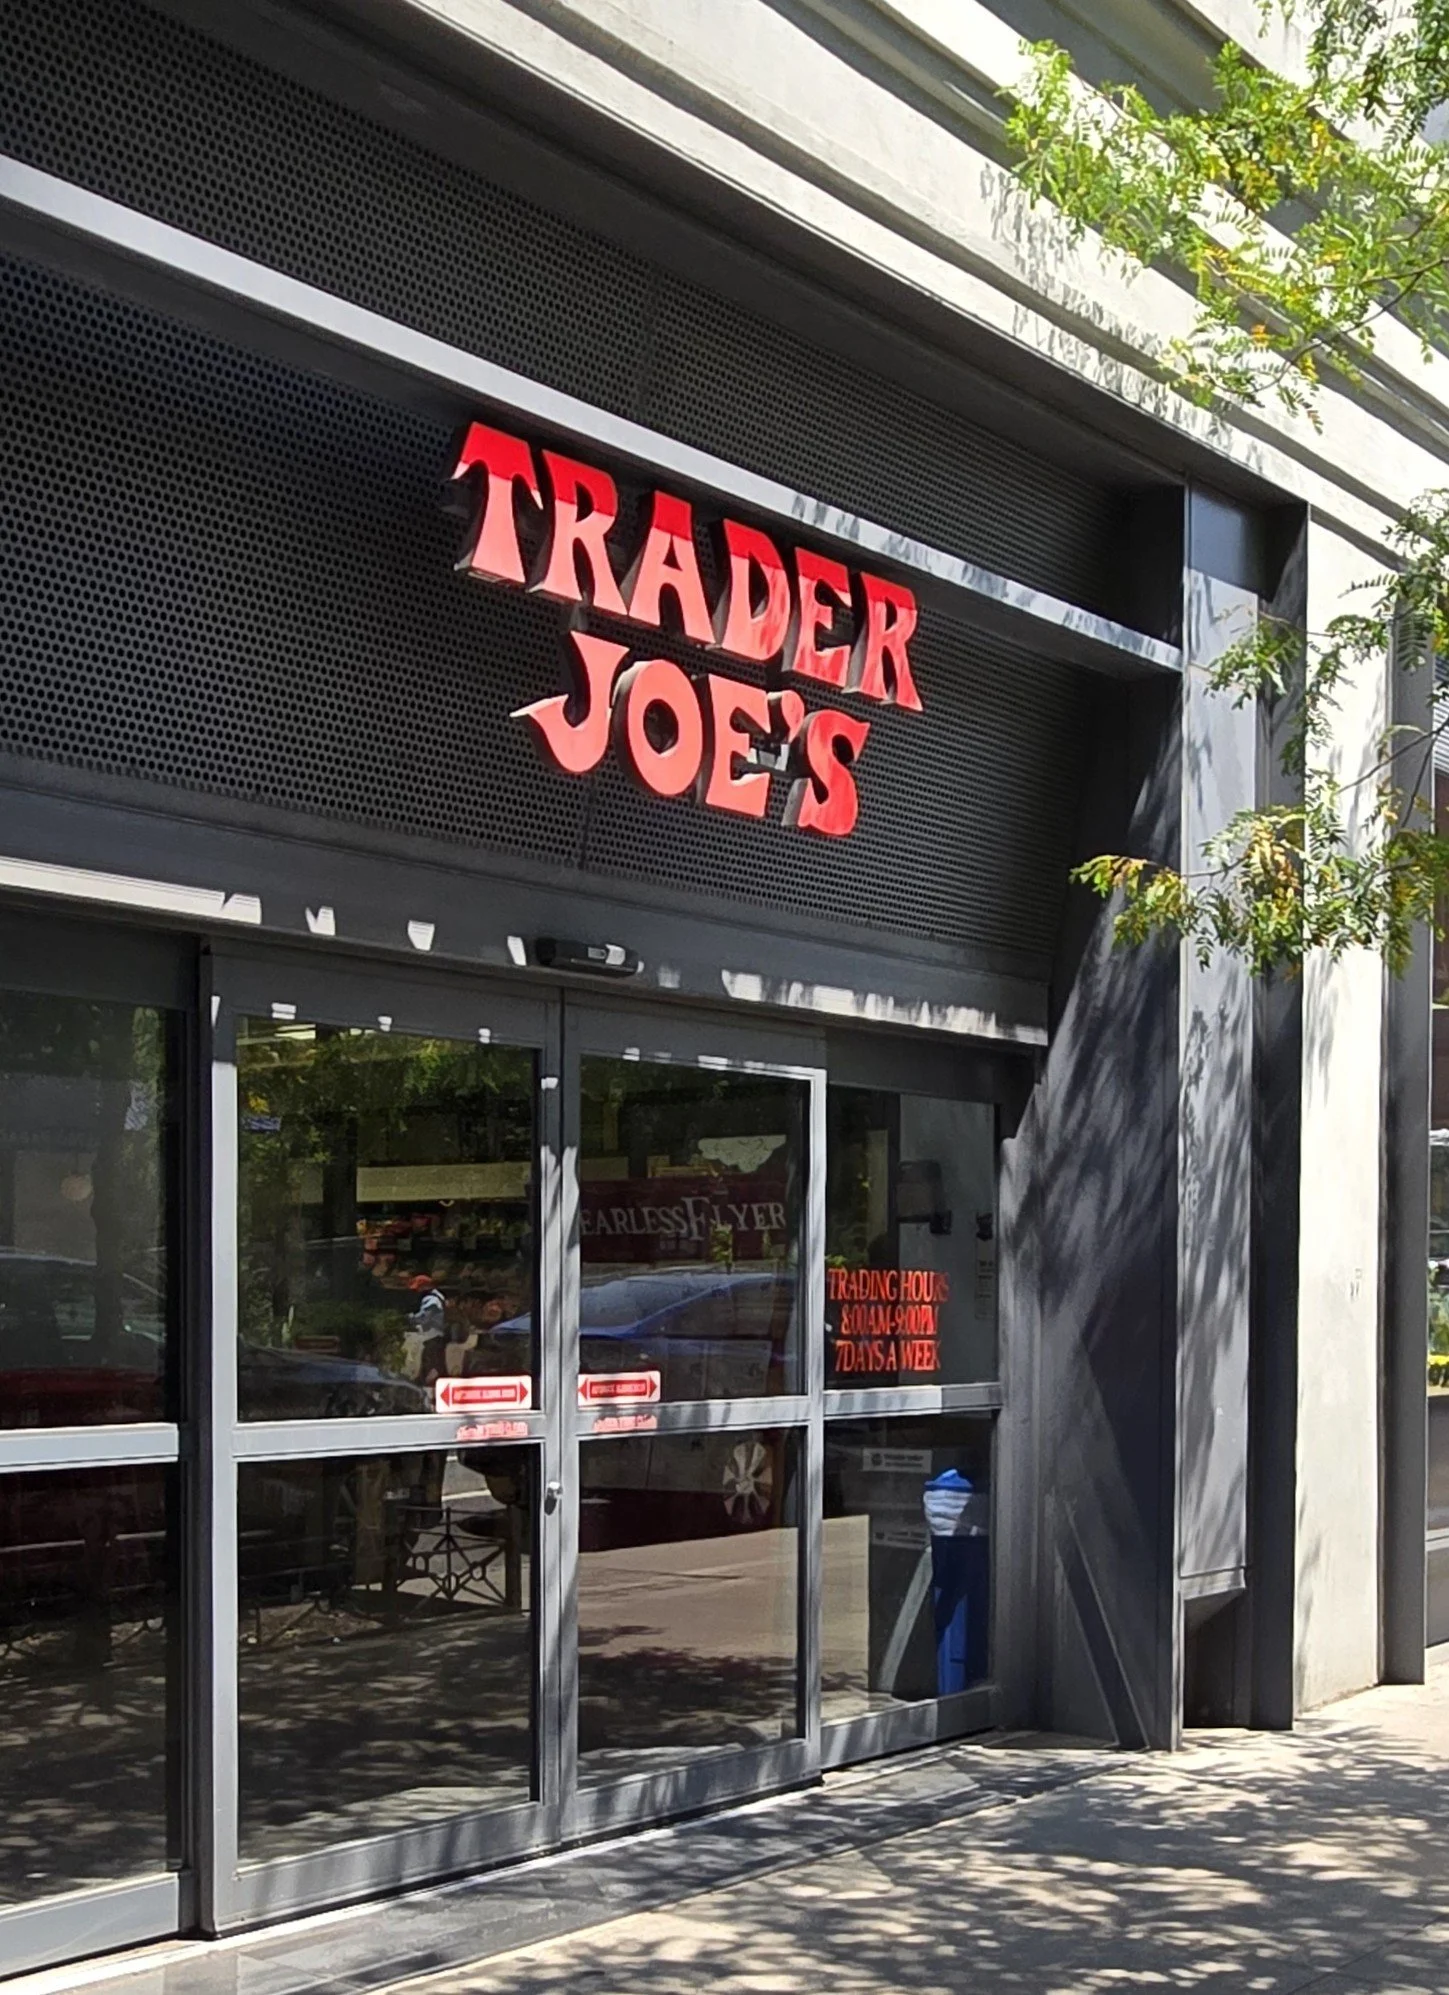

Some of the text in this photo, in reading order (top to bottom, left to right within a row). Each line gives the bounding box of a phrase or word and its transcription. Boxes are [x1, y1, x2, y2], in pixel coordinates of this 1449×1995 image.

[452, 421, 923, 711] TRADER
[510, 631, 871, 837] JOE'S
[580, 1206, 688, 1236] EARLESS
[827, 1267, 897, 1301] TRADING
[901, 1270, 949, 1303] HOURS
[901, 1339, 941, 1371] WEEK
